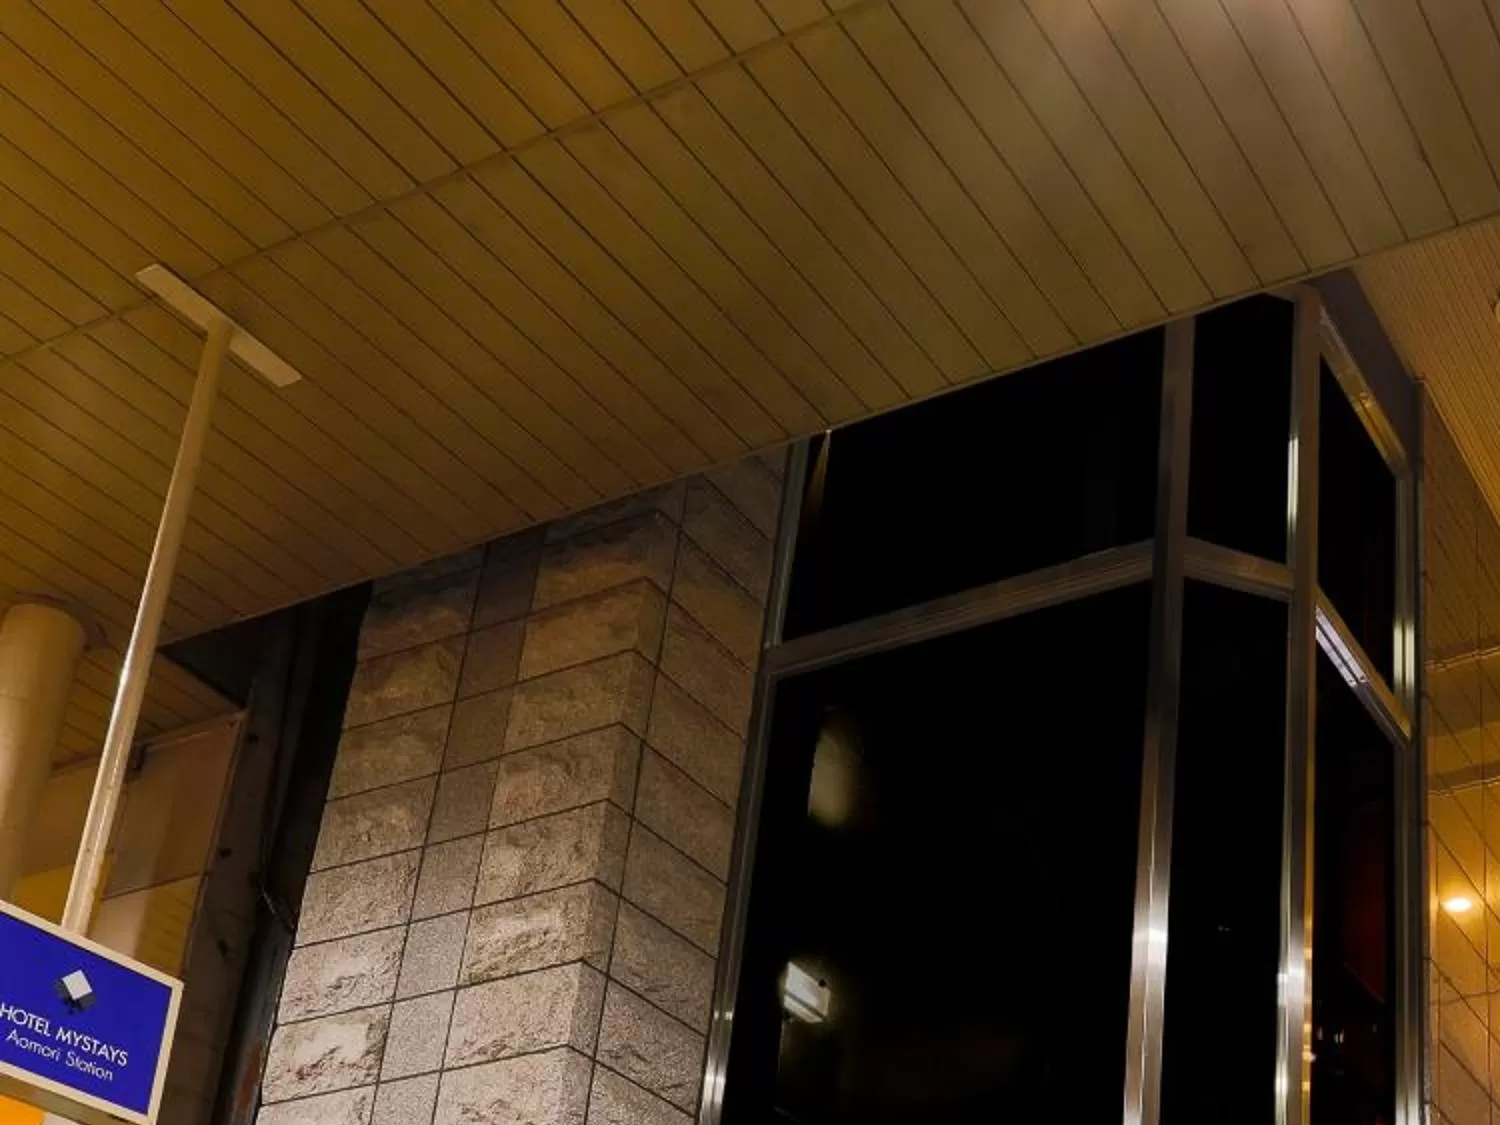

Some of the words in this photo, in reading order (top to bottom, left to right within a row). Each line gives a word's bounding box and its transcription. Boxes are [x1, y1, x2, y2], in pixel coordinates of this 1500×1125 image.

[0, 1002, 52, 1037] HOTEL
[55, 1026, 129, 1067] MYSTAYS
[6, 1028, 61, 1062] Aomori
[65, 1051, 114, 1082] Station
